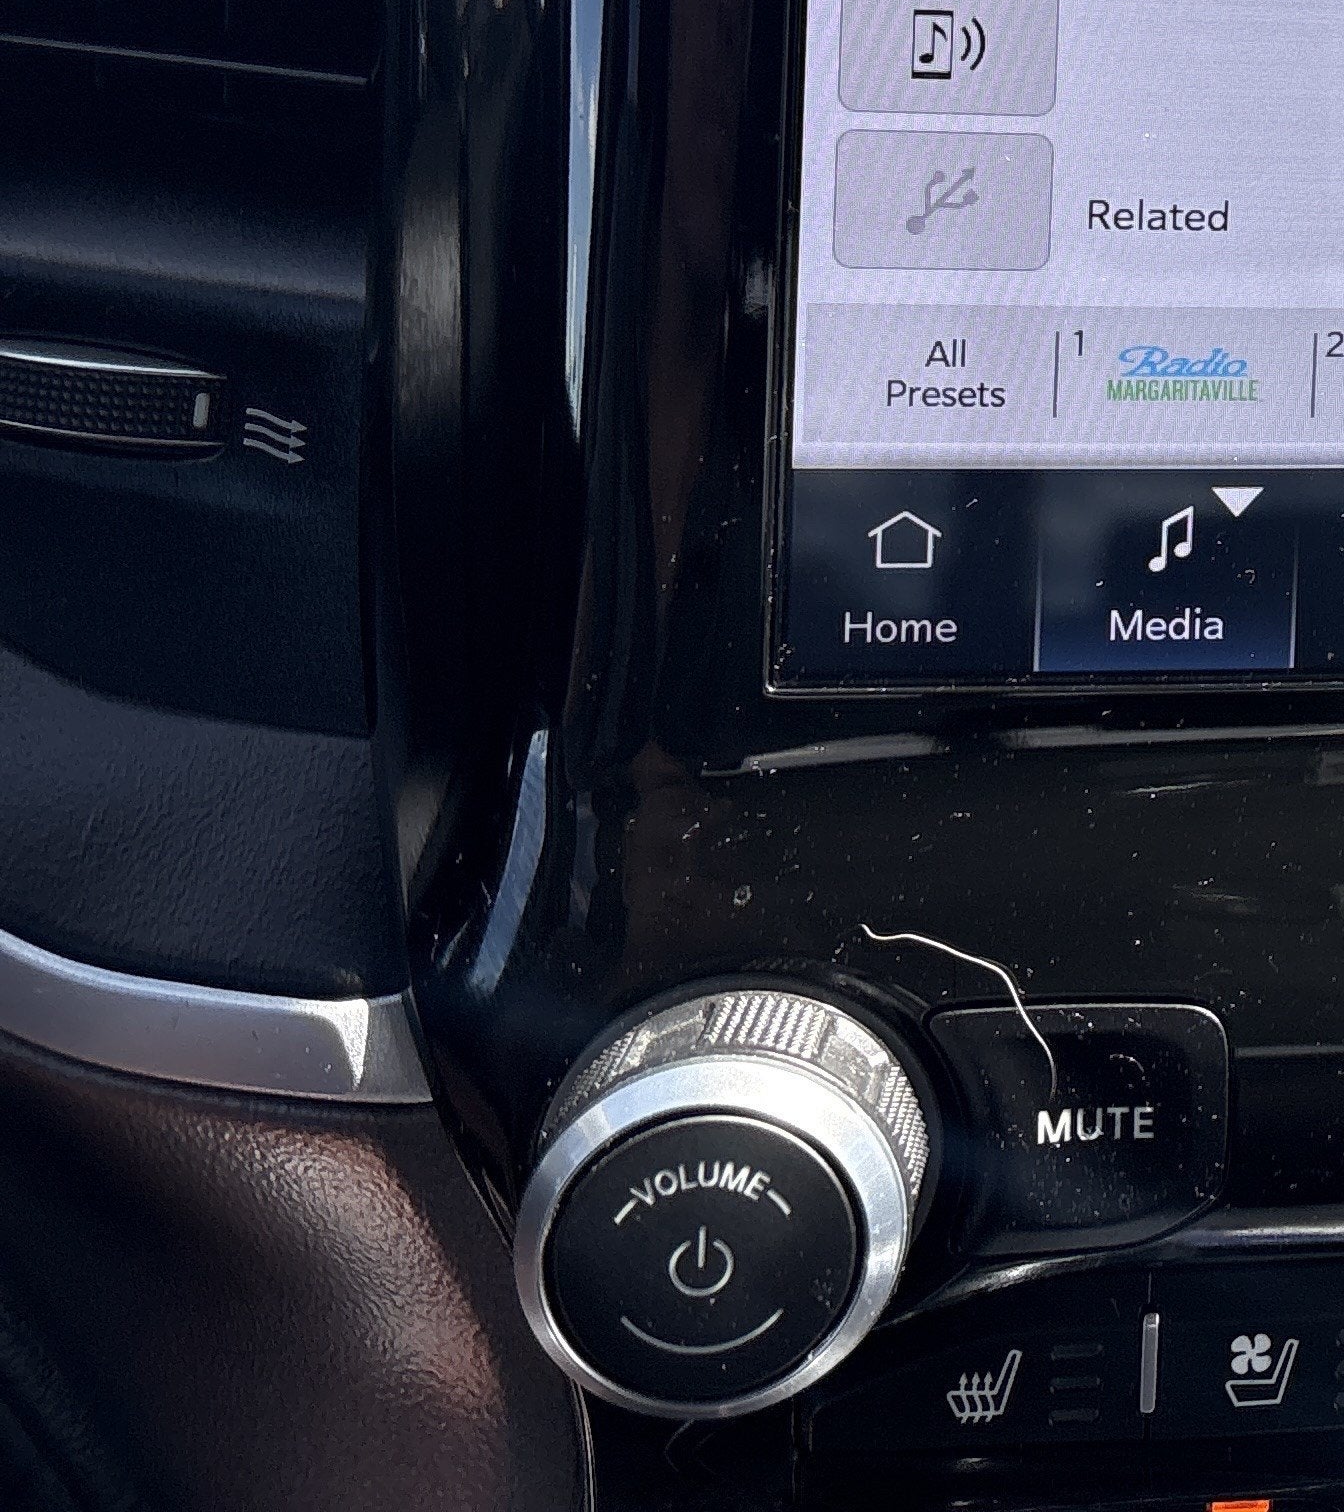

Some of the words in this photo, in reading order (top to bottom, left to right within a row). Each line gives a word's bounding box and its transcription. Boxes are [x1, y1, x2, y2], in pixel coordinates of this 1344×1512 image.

[1088, 198, 1229, 232] Related
[924, 338, 967, 368] All
[1073, 329, 1084, 357] 1
[1325, 330, 1344, 358] 2
[1118, 345, 1248, 377] Radio
[886, 379, 1006, 408] Presets
[1106, 379, 1259, 402] MARGARITAVILLE
[844, 611, 958, 643] Home
[1109, 607, 1224, 641] Media
[1036, 1106, 1153, 1148] MUTE
[630, 1160, 772, 1210] VOLUME
